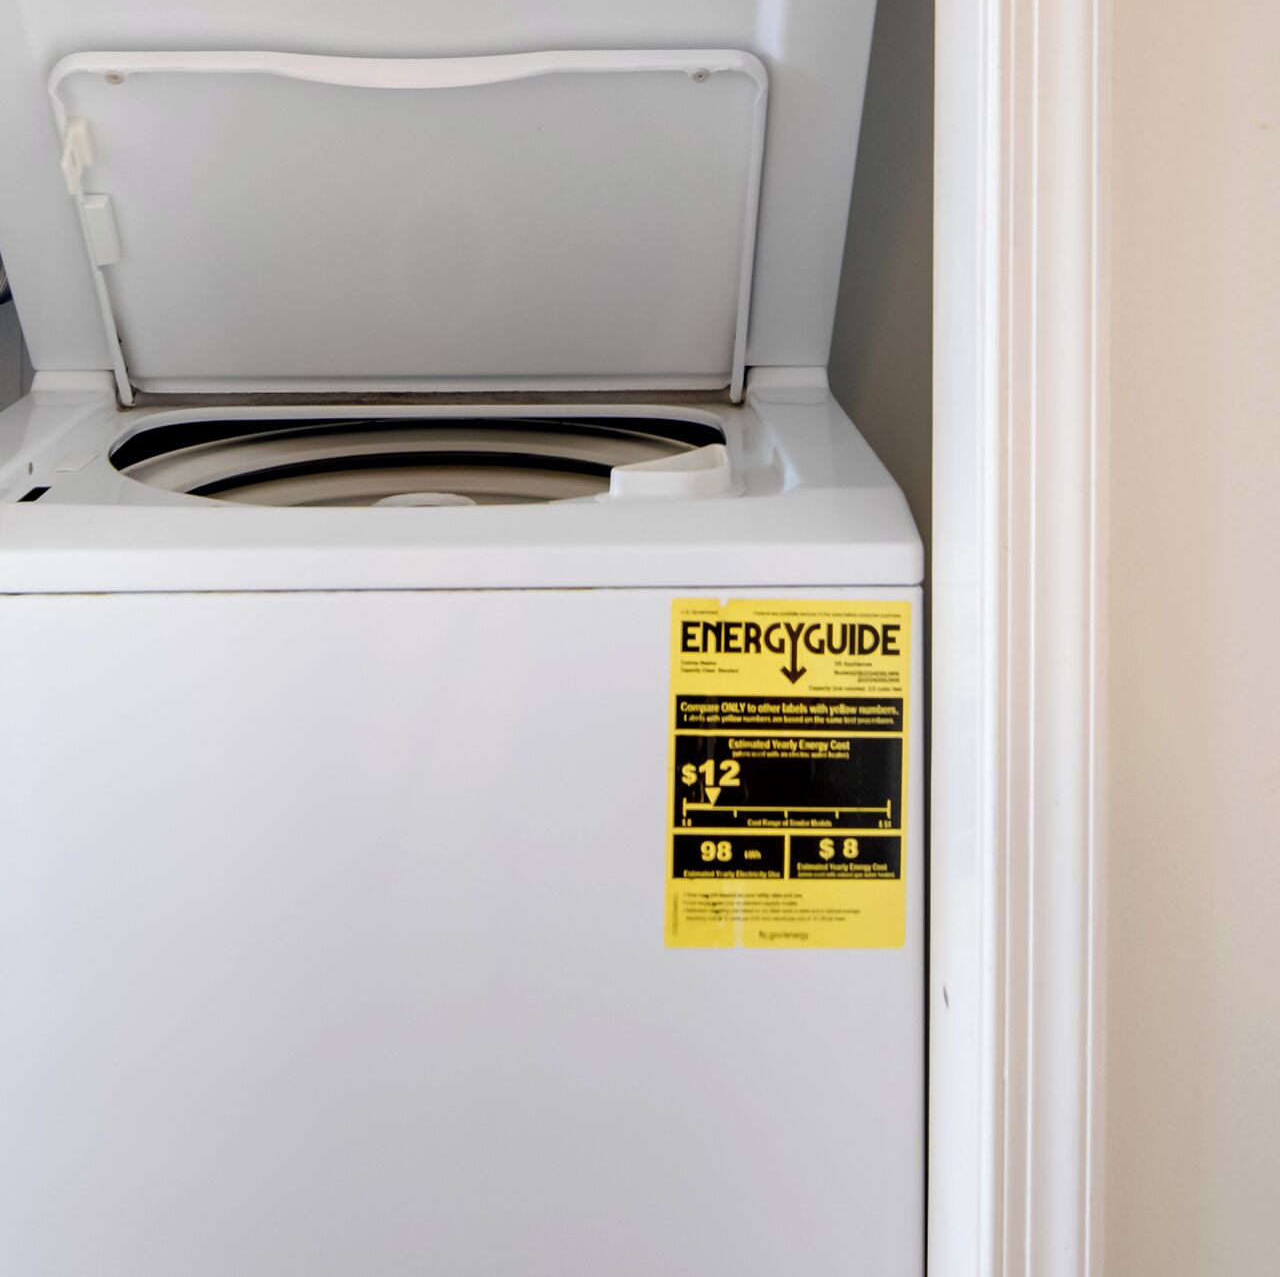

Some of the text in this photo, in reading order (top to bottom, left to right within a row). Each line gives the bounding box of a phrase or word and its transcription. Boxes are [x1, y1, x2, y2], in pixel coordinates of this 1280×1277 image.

[681, 620, 901, 658] ENERGYGUIDE
[680, 701, 900, 717] Compare ONLY to other labels with yellow numbers.
[728, 738, 851, 754] Estimated Yearly Energy Cost
[681, 759, 741, 788] $12
[747, 818, 762, 827] Cost
[762, 818, 782, 828] Range
[700, 840, 733, 863] 98
[818, 837, 860, 862] $ 8
[797, 862, 888, 873] Estimated Yearly Energy Cost
